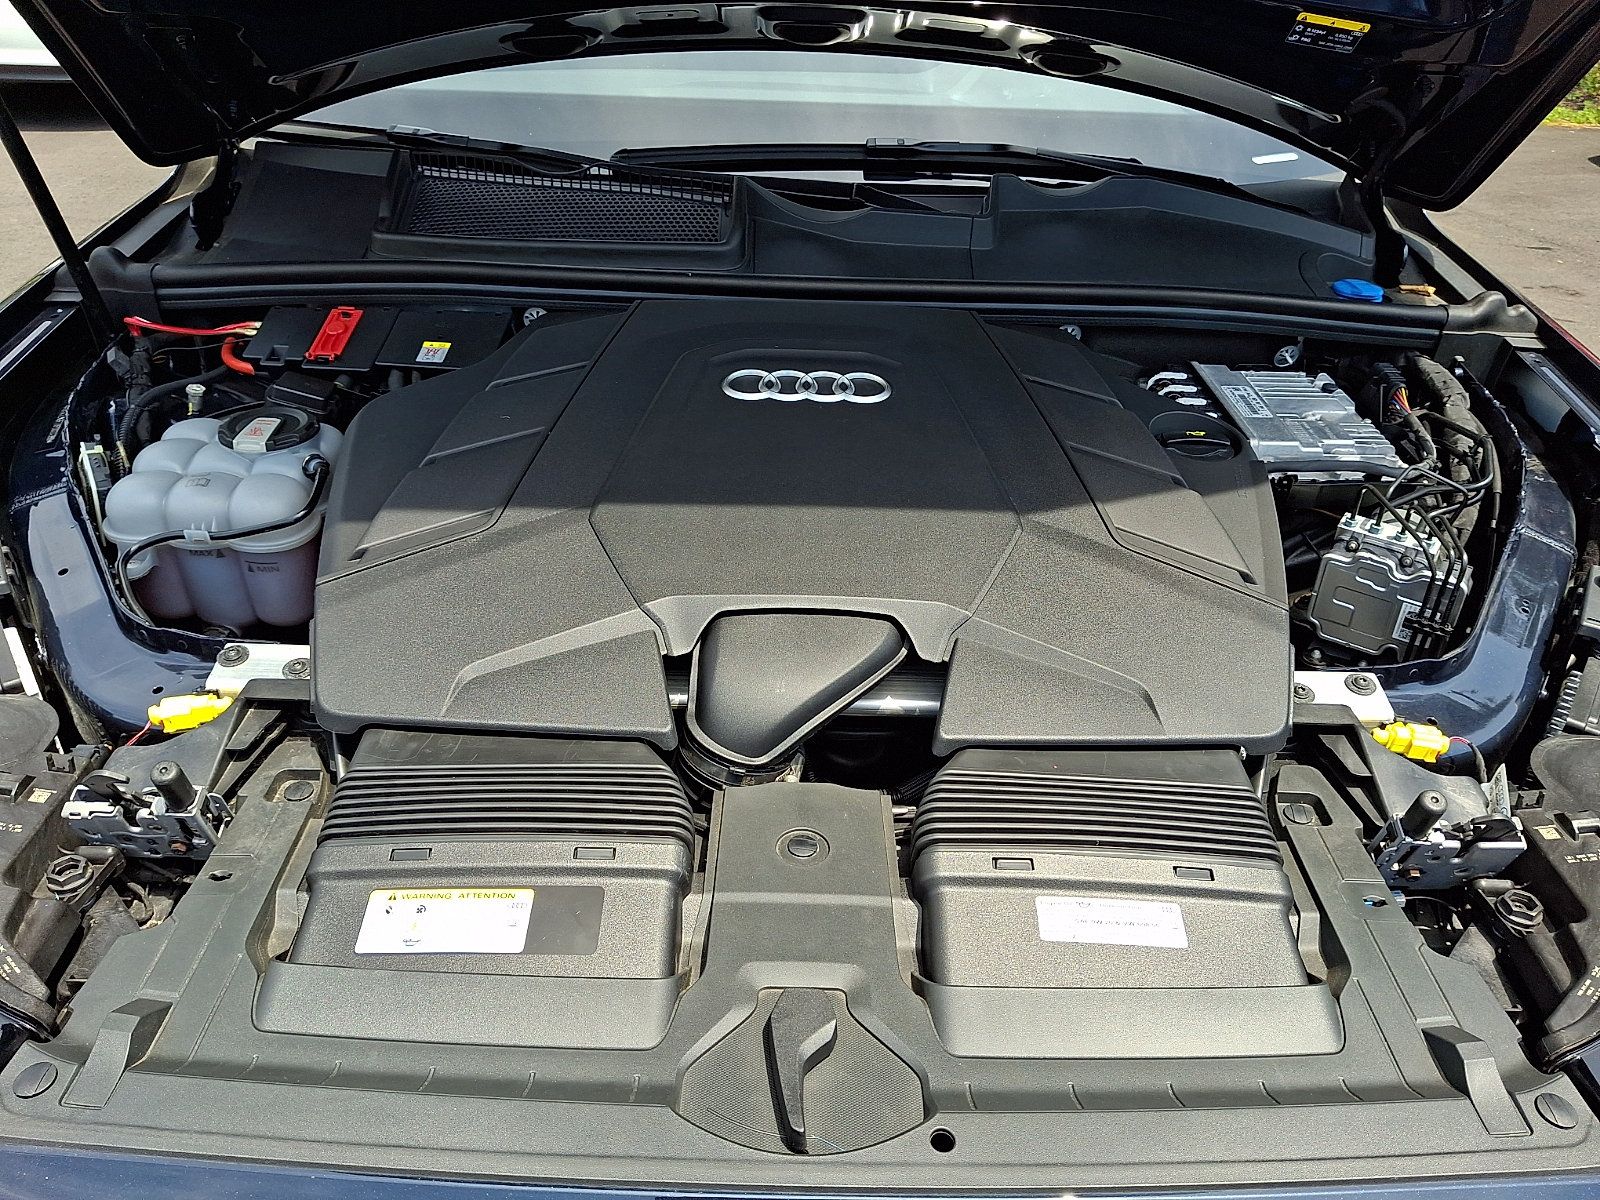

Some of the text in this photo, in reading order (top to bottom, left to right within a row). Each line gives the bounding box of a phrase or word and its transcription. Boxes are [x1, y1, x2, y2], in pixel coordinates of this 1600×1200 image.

[188, 549, 214, 557] MAX
[256, 565, 280, 573] MIN
[401, 892, 452, 900] WARNING
